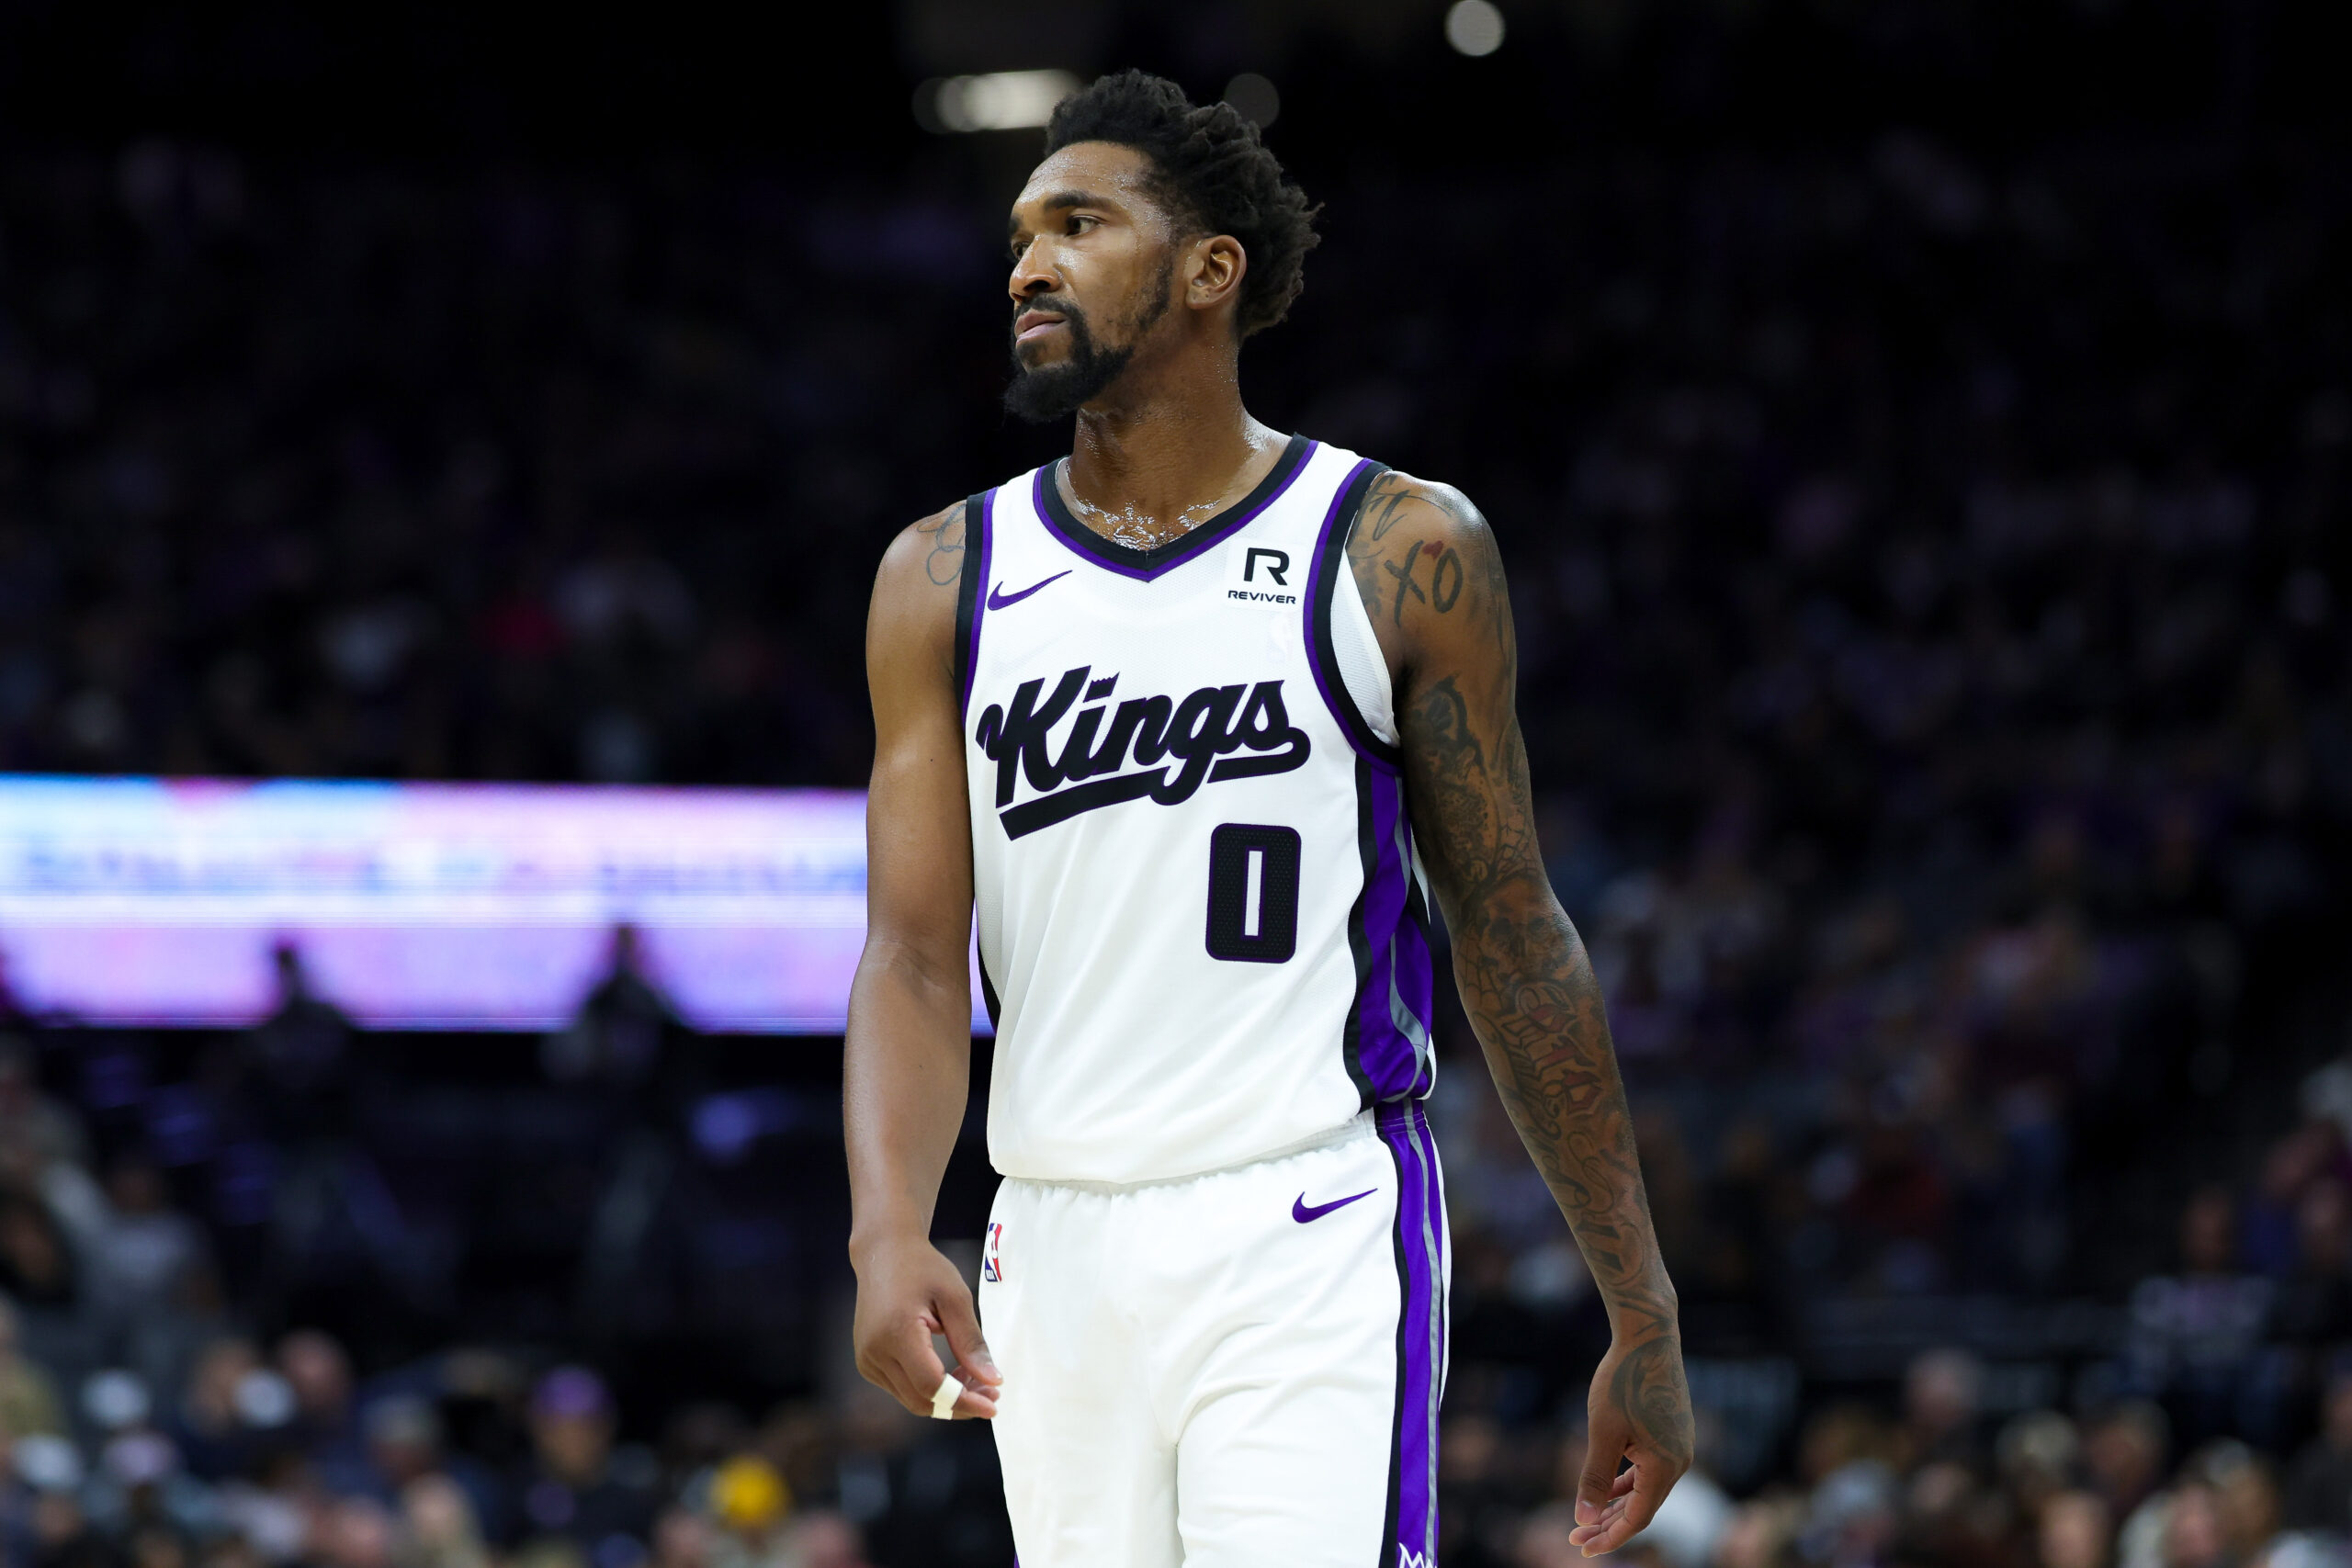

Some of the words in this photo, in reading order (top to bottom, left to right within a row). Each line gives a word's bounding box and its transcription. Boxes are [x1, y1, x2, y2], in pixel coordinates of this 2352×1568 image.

[1227, 590, 1296, 604] REVIVER
[1243, 547, 1290, 586] R
[1384, 539, 1464, 628] XO
[975, 664, 1311, 841] Kings
[1205, 822, 1302, 964] 0
